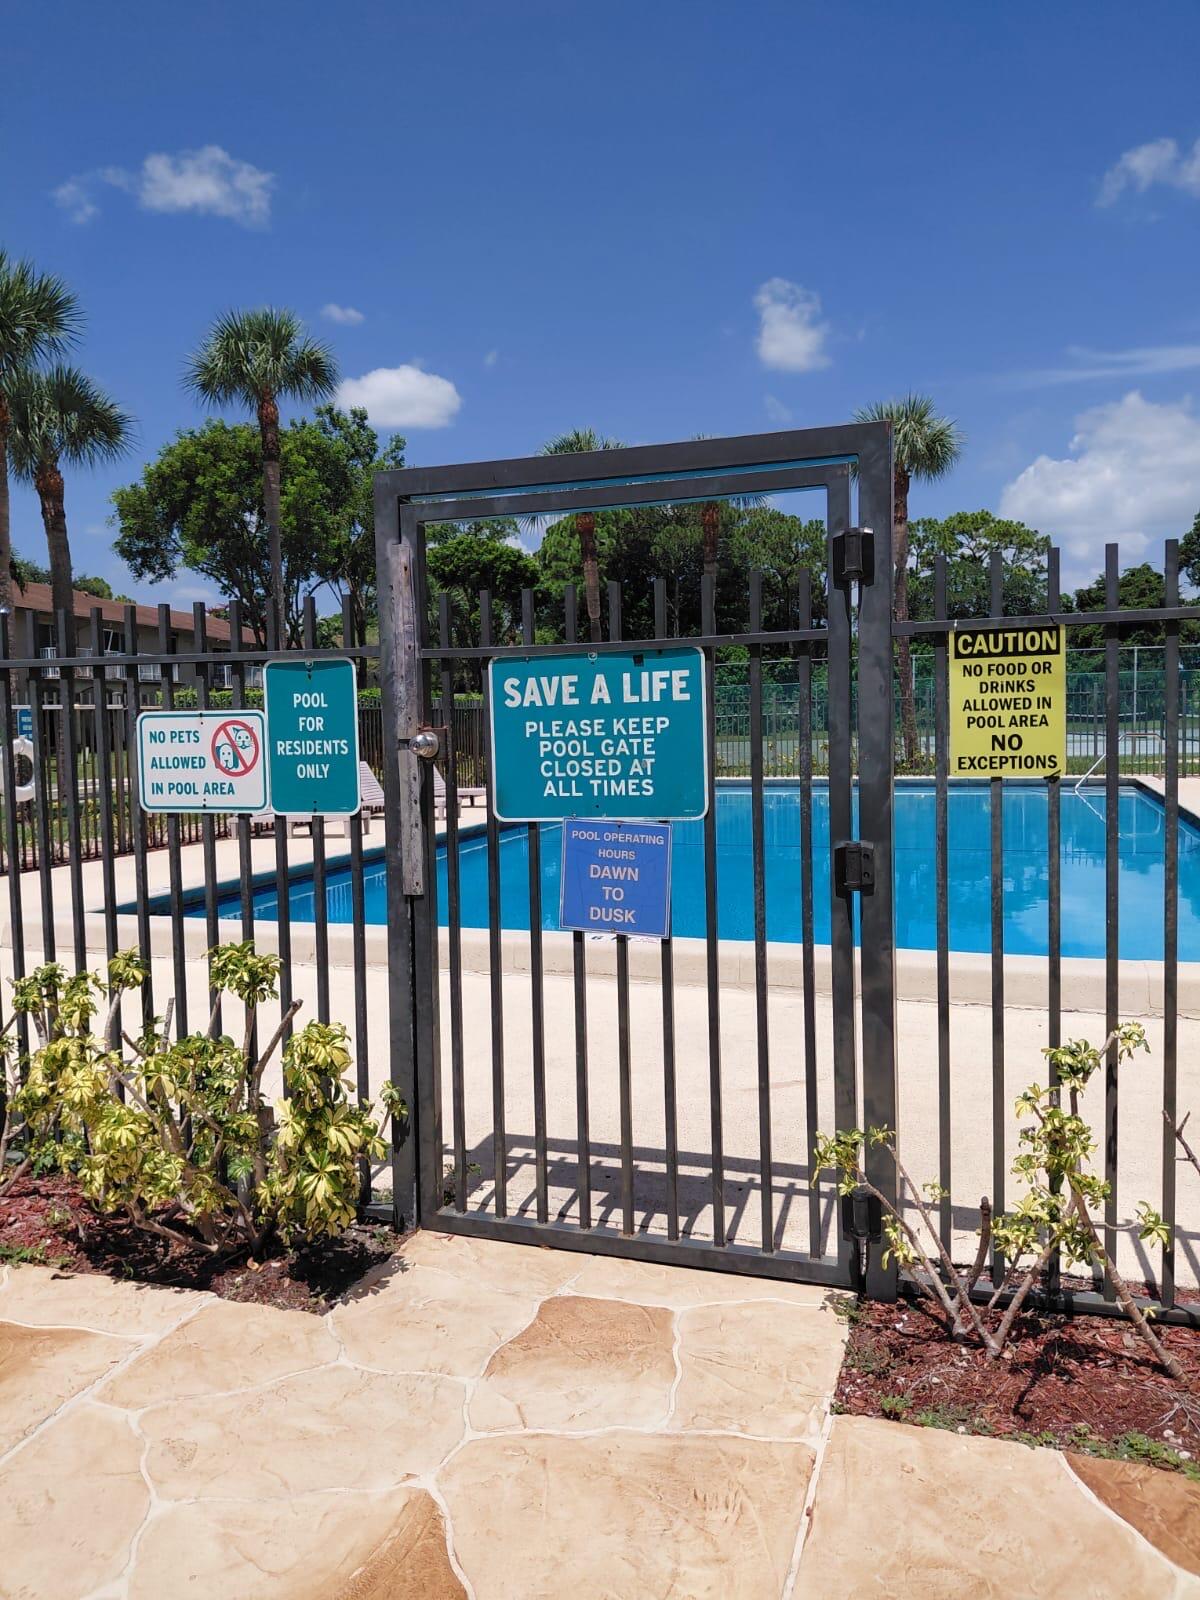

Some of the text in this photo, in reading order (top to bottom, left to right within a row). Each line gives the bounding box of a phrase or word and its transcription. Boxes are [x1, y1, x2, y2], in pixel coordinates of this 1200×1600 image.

[957, 632, 1058, 655] CAUTION
[962, 662, 1052, 677] NO FOOD OR
[504, 670, 690, 708] SAVE A LIFE
[293, 693, 328, 708] POOL
[962, 697, 1051, 712] ALLOWED IN
[299, 717, 324, 732] FOR
[526, 717, 670, 737] PLEASE KEEP
[967, 714, 1049, 728] POOL AREA
[149, 730, 200, 743] NO PETS
[991, 734, 1023, 751] NO
[277, 740, 348, 755] RESIDENTS
[540, 738, 655, 757] POOL GATE
[151, 757, 206, 769] ALLOWED
[540, 759, 655, 777] CLOSED AT
[958, 755, 1058, 770] EXCEPTIONS
[297, 764, 329, 779] ONLY
[151, 782, 235, 795] IN POOL AREA
[544, 780, 654, 796] ALL TIMES
[572, 831, 664, 845] POOL OPERATING
[598, 849, 635, 860] HOURS
[590, 865, 639, 881] DAWN
[602, 887, 624, 901] TO
[590, 907, 635, 923] DUSK
